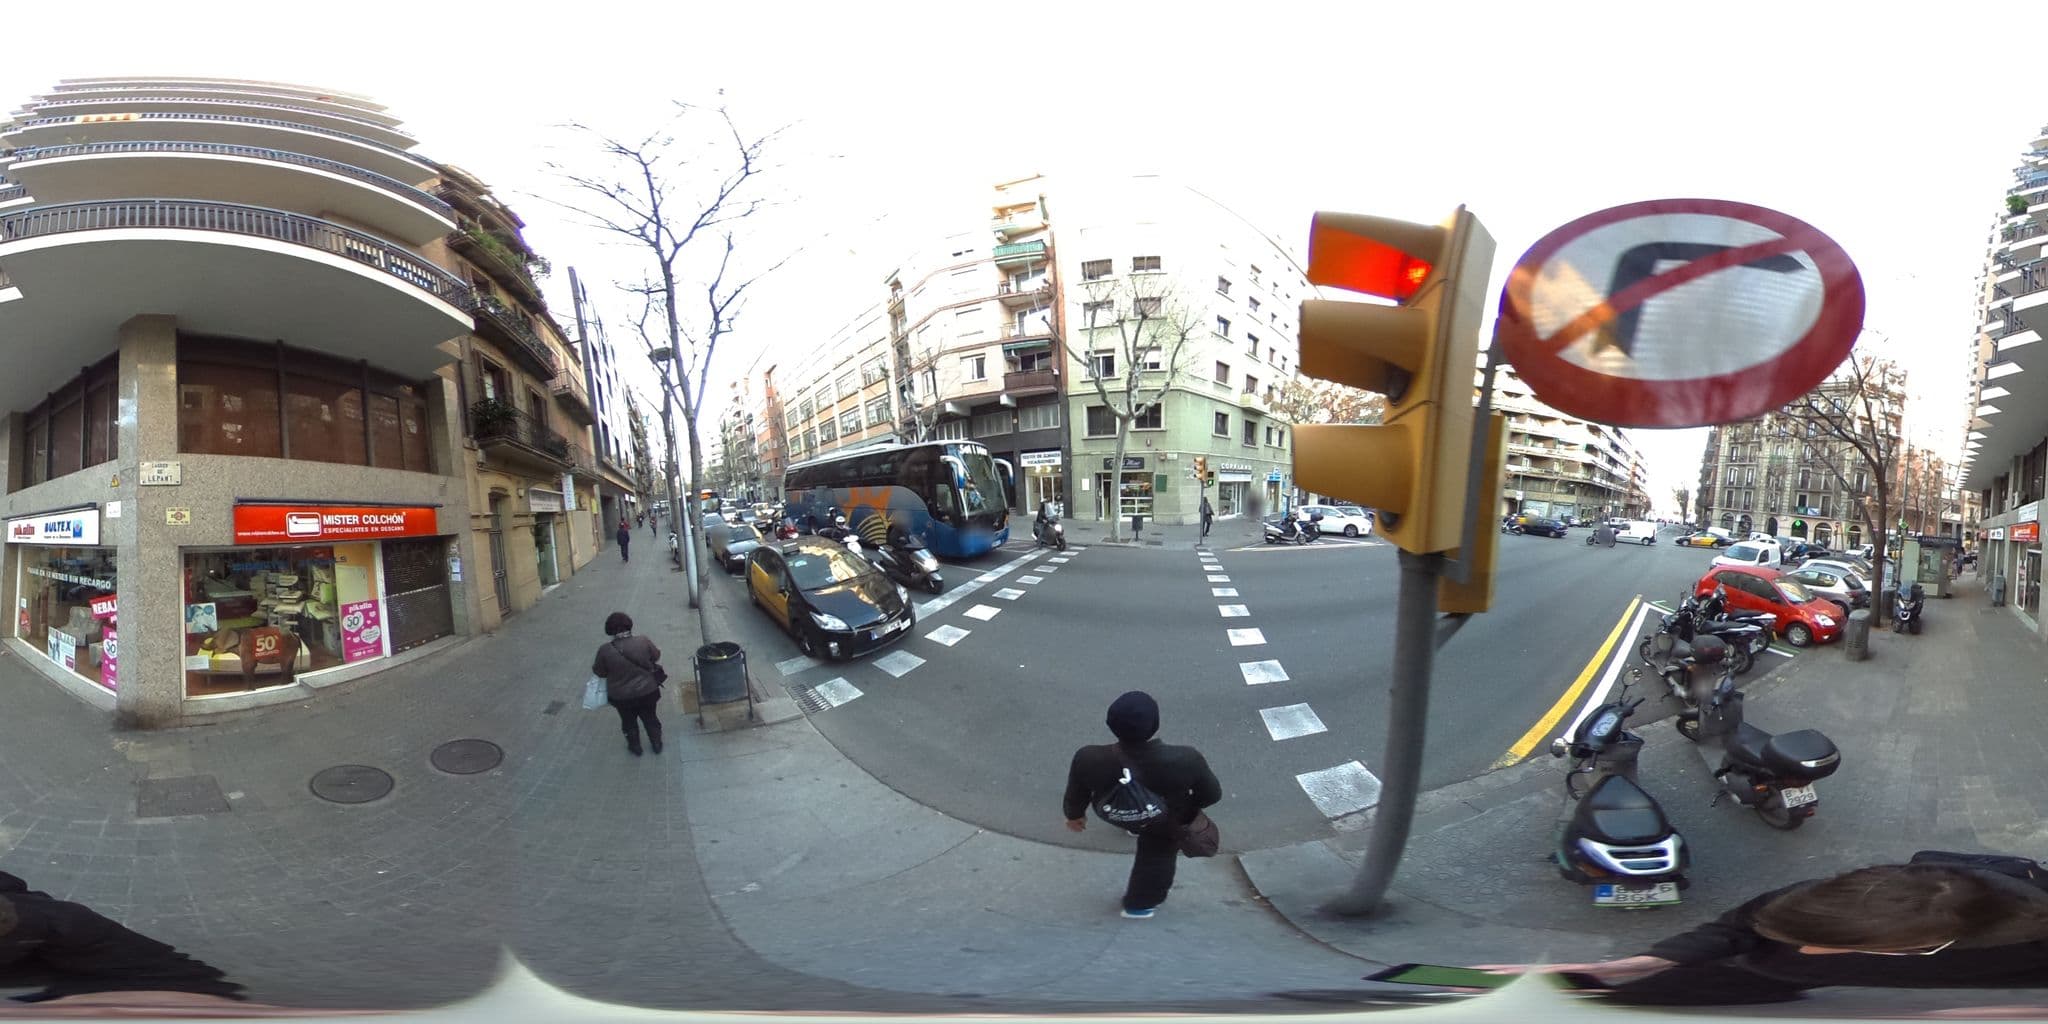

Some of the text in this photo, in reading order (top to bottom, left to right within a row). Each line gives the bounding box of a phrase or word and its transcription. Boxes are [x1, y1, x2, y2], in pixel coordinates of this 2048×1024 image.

[322, 512, 404, 525] MISTER COLCHÓN
[44, 520, 72, 533] BULTEX
[323, 526, 369, 534] ESPECIALISTES
[79, 575, 111, 589] RECARGO
[92, 600, 117, 614] REBAJ
